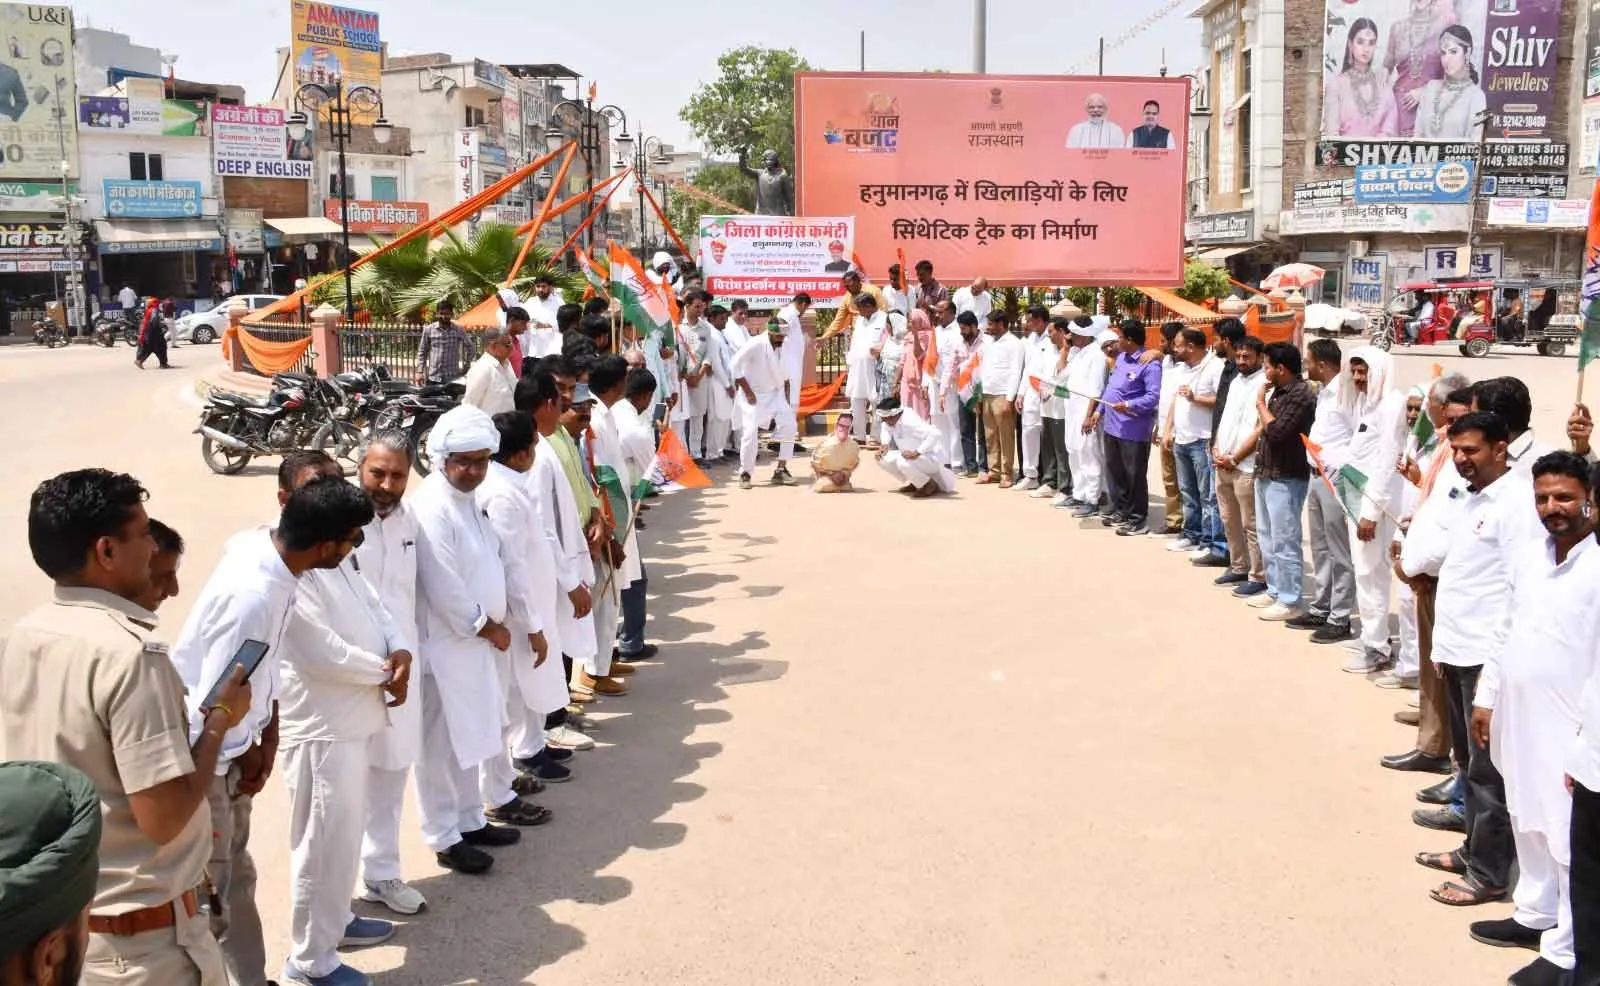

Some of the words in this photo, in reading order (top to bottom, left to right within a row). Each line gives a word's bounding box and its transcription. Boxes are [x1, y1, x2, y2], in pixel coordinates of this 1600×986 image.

[28, 7, 65, 25] U&i
[307, 4, 378, 31] ANANTAM
[306, 24, 341, 38] PUBLIC
[344, 30, 379, 44] SCHOOL
[1488, 25, 1554, 67] Shiv
[1488, 72, 1550, 92] Jewellers
[843, 129, 898, 147] बजट
[968, 135, 1024, 147] राजस्थान
[1345, 143, 1440, 166] SHYAM
[1445, 145, 1492, 154] CONTT
[1494, 145, 1515, 153] FOR
[1518, 144, 1541, 154] THIS
[1544, 144, 1567, 154] SITE
[217, 160, 251, 175] DEEP
[256, 161, 311, 177] ENGLISH
[110, 186, 126, 199] जय
[859, 184, 949, 206] हनुमानगढ़
[954, 179, 969, 201] में
[974, 180, 1064, 206] खिलाड़ियों
[1069, 180, 1088, 201] के
[1093, 180, 1128, 202] लिए
[725, 220, 761, 238] जिला
[764, 220, 806, 238] कांग्रेस
[809, 222, 848, 238] कमेटी
[892, 218, 970, 240] सिंथेटिक
[975, 217, 1006, 245] ट्रैक
[1010, 224, 1036, 240] का
[1041, 218, 1098, 240] निर्माण
[752, 241, 793, 249] हनुमानगढ़
[713, 278, 742, 290] विरोध
[744, 278, 777, 291] प्रदर्शन
[778, 281, 786, 290] व
[787, 281, 817, 294] पुतला
[818, 281, 840, 292] दहन
